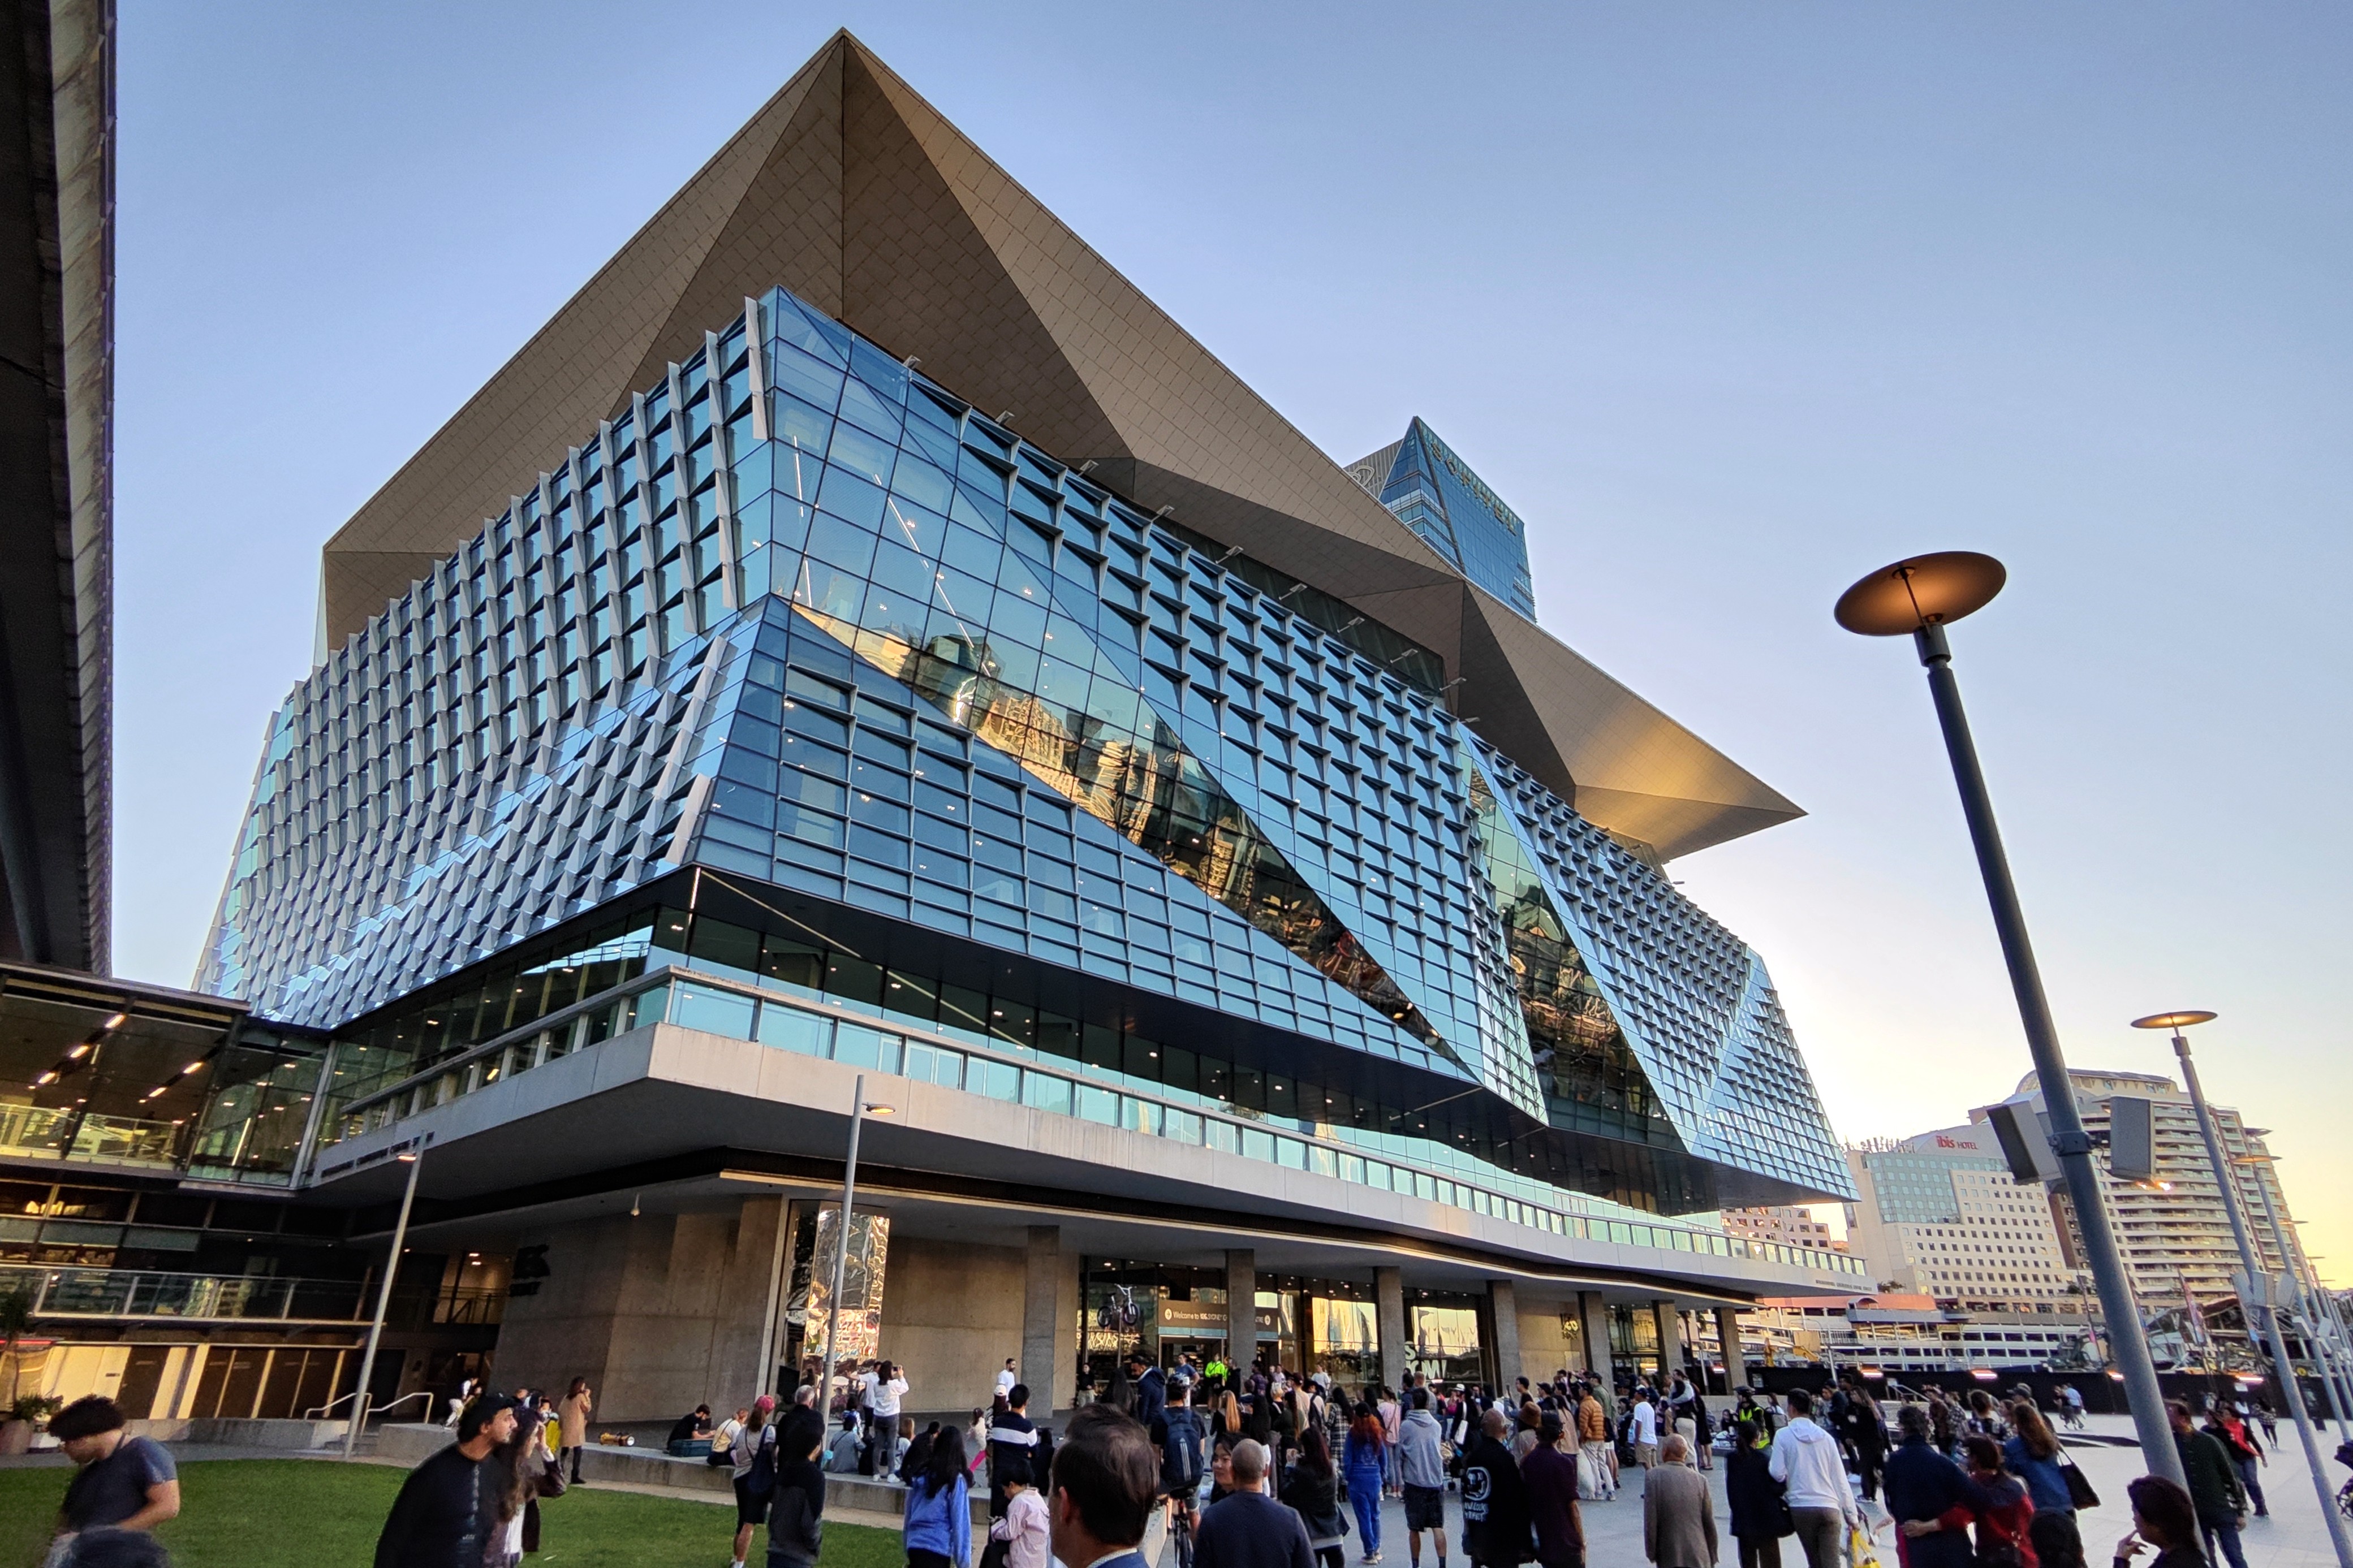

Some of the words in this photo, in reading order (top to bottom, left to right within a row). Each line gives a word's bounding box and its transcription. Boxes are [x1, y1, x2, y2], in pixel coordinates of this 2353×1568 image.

[1431, 442, 1518, 537] SOFITEL
[1936, 1135, 1955, 1148] ibis
[1173, 1311, 1193, 1319] Welcome
